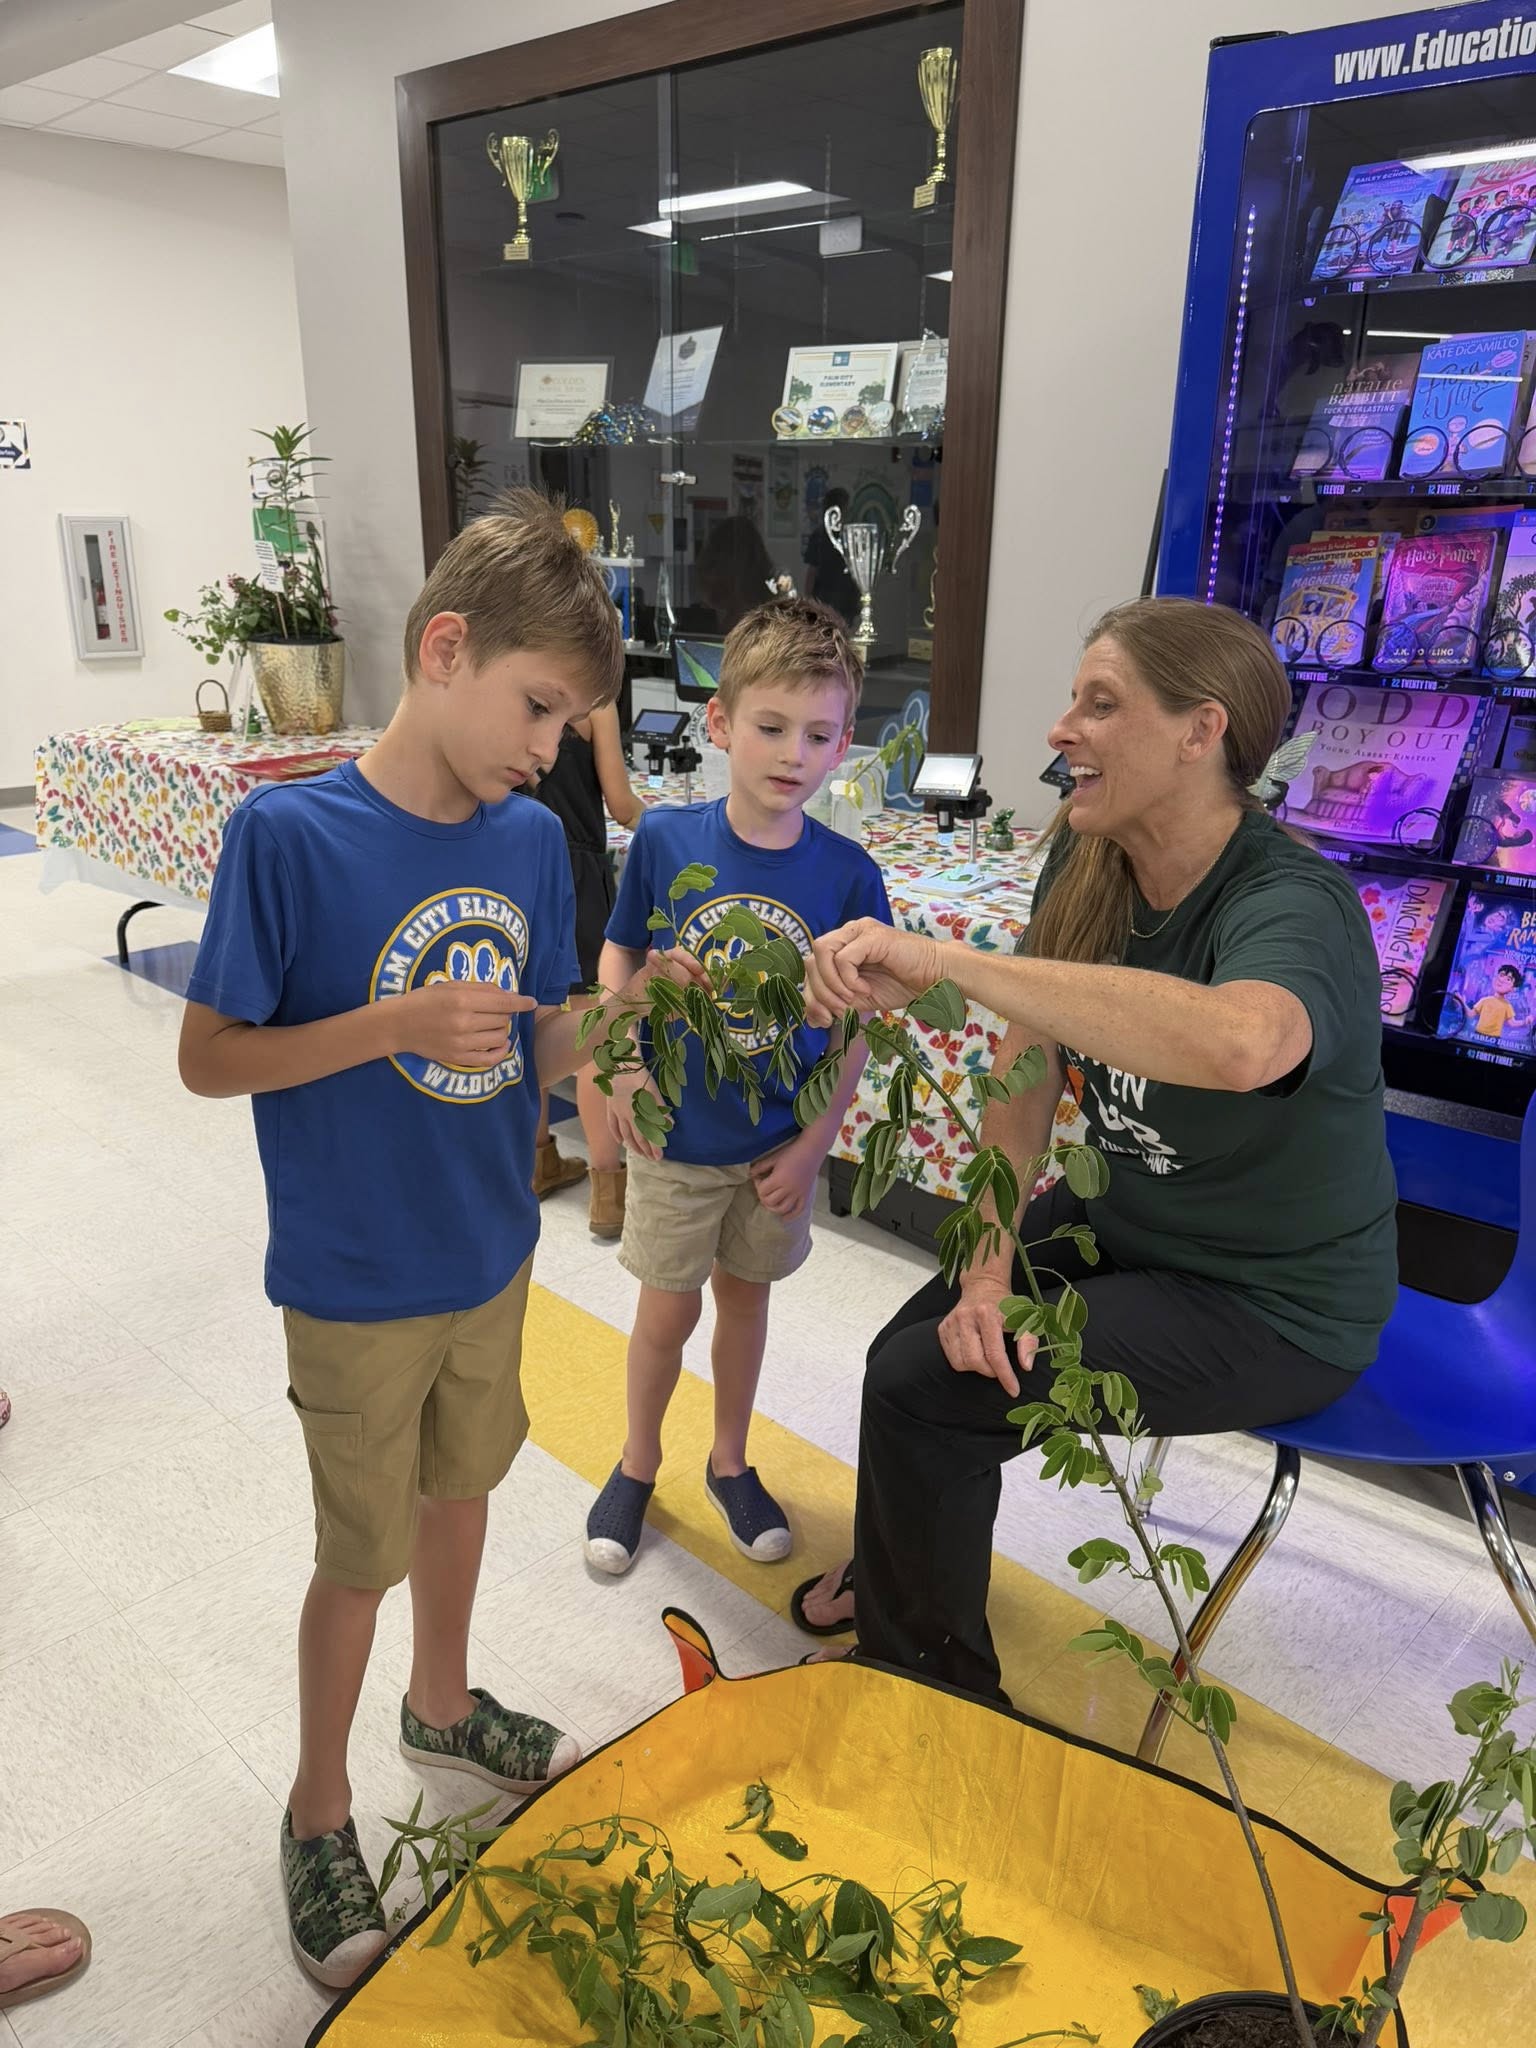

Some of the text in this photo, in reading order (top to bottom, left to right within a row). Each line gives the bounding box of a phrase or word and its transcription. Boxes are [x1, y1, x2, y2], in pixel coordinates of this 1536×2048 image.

[1427, 349, 1454, 360] KATE
[1323, 405, 1395, 414] TUCK EVERLASTING
[1436, 484, 1461, 495] TWELVE
[1347, 550, 1373, 558] BOOK
[1404, 545, 1481, 567] Harry Potter
[107, 530, 128, 643] FIRE EXTINGUISHER
[1292, 573, 1360, 588] MAGNETISM
[1391, 679, 1438, 690] 22 TWENTY TWO
[1316, 686, 1470, 729] ODD
[1311, 720, 1460, 750] BOY OUT
[1320, 743, 1437, 761] YOUNG ALBERT EINSTEIN
[699, 901, 740, 930] CIT
[380, 950, 413, 1000] LM
[403, 901, 453, 948] CITY
[1476, 1050, 1496, 1064] FORTY
